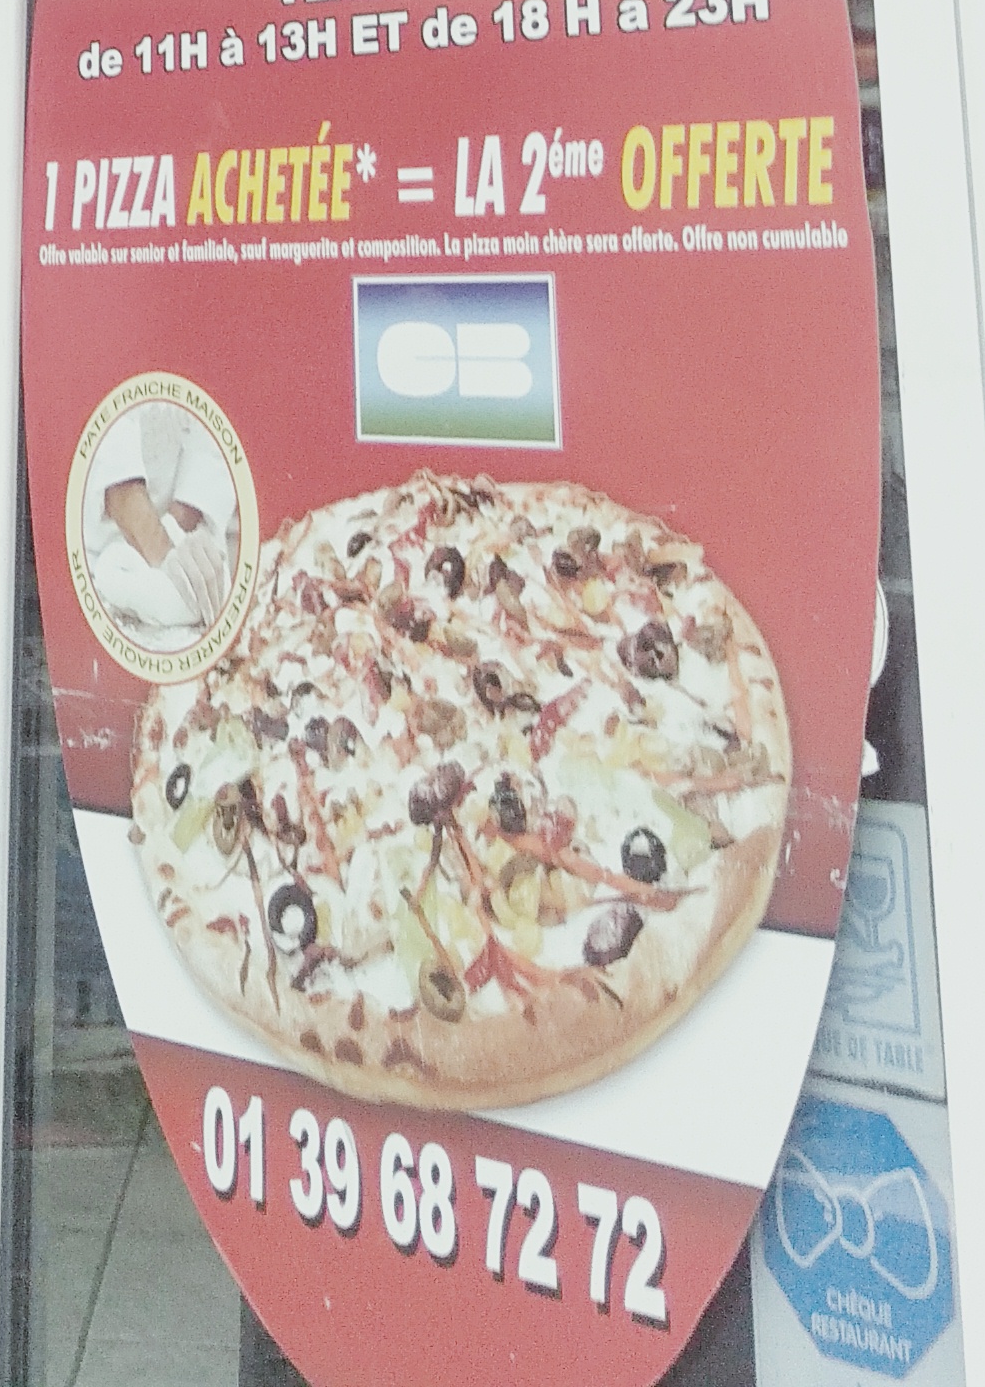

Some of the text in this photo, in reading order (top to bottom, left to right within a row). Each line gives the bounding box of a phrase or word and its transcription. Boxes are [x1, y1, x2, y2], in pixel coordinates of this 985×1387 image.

[78, 41, 124, 80] de
[134, 30, 208, 74] 11H
[219, 27, 245, 66] à
[257, 17, 337, 64] 13H
[351, 10, 409, 56] ET
[421, 6, 478, 50] de
[44, 161, 59, 232] 1
[71, 154, 176, 231] PIZZA
[454, 134, 506, 217] LA
[621, 116, 834, 211] OFFERTE
[39, 220, 848, 266] Offre valable sur senior et familiale, sauf marguerita et composition. La pizza moin chère sera offerte. Offre non cumulable
[376, 321, 532, 399] CB
[79, 380, 243, 466] PATE FRAICHE MAISON
[71, 550, 253, 674] PREPARER CHAQUE JOUR
[203, 1085, 668, 1325] 01 39 68 72 72
[811, 1311, 913, 1363] RESTAURANT
